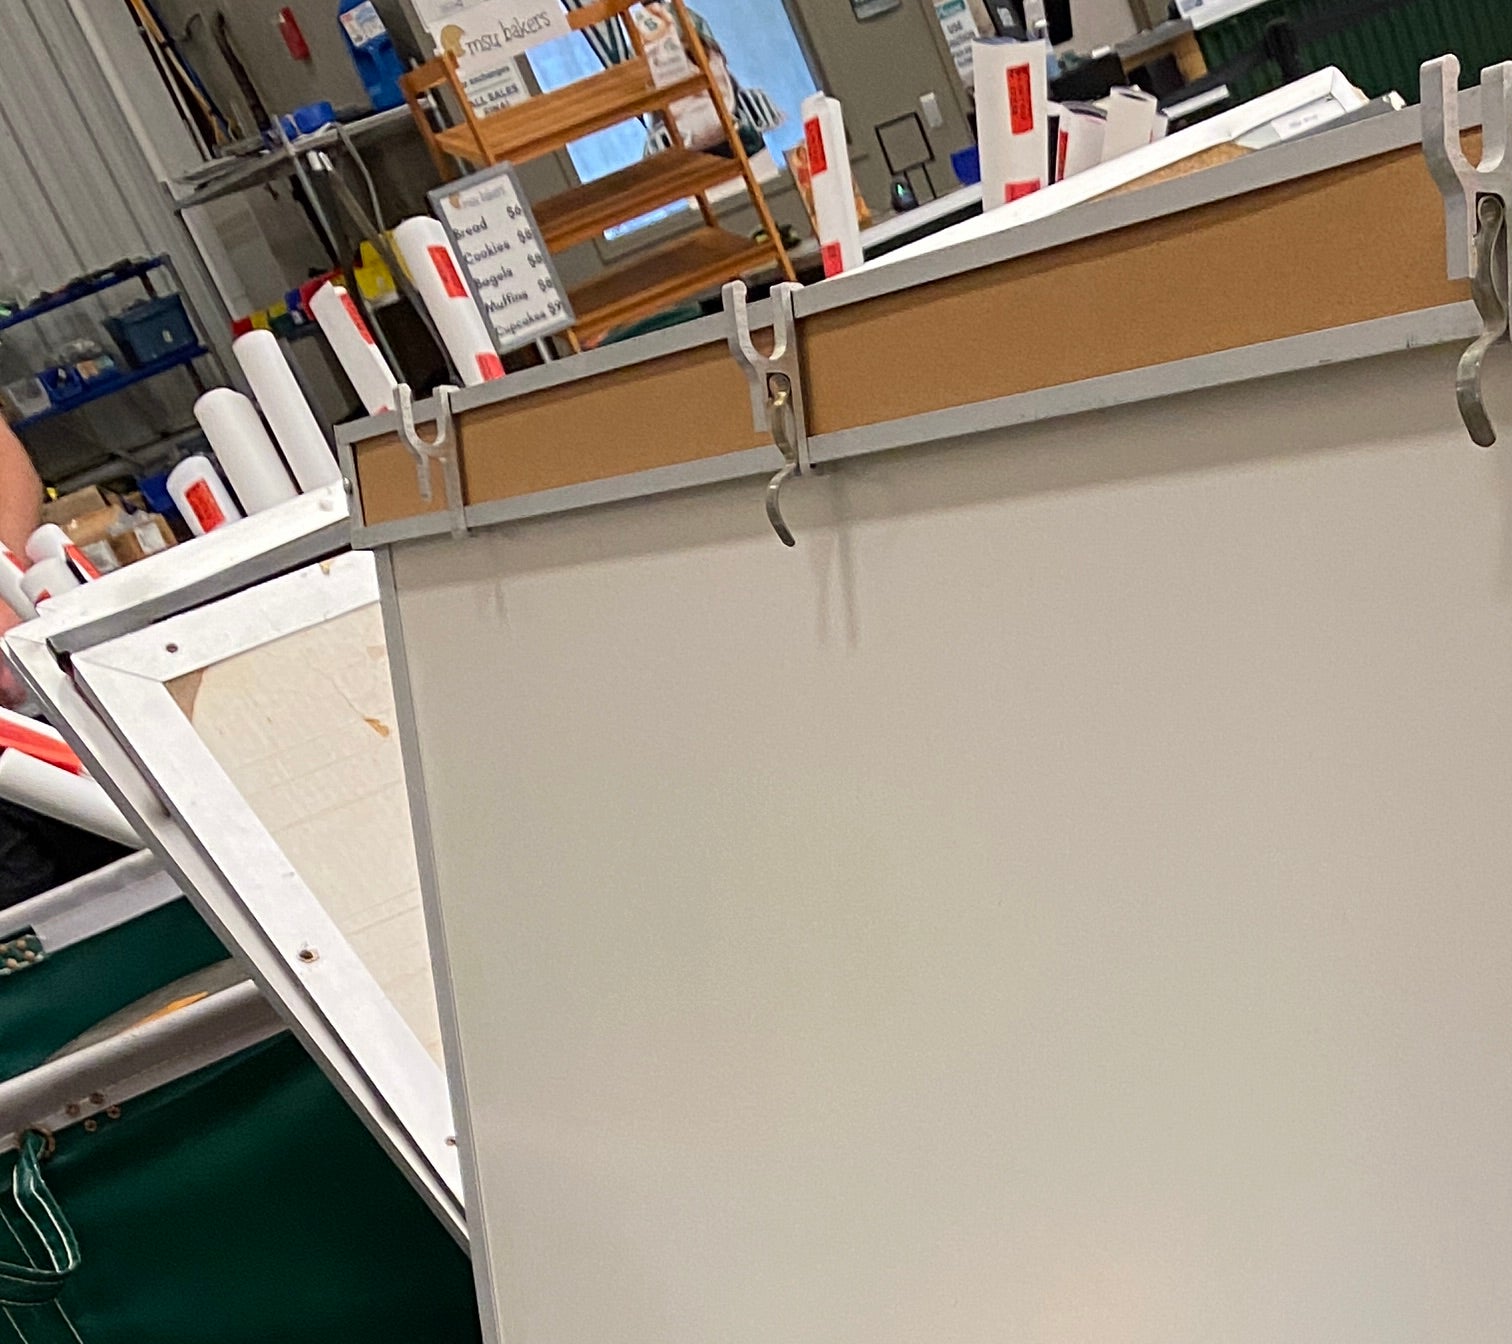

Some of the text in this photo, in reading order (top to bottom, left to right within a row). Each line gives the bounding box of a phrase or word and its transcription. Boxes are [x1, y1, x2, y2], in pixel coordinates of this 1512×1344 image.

[465, 11, 551, 56] msu bakers
[453, 216, 488, 240] Bread
[464, 241, 511, 265] Cookies
[474, 266, 513, 289] Bagels
[486, 291, 529, 312] Muffins
[496, 311, 547, 335] Cupcakes
